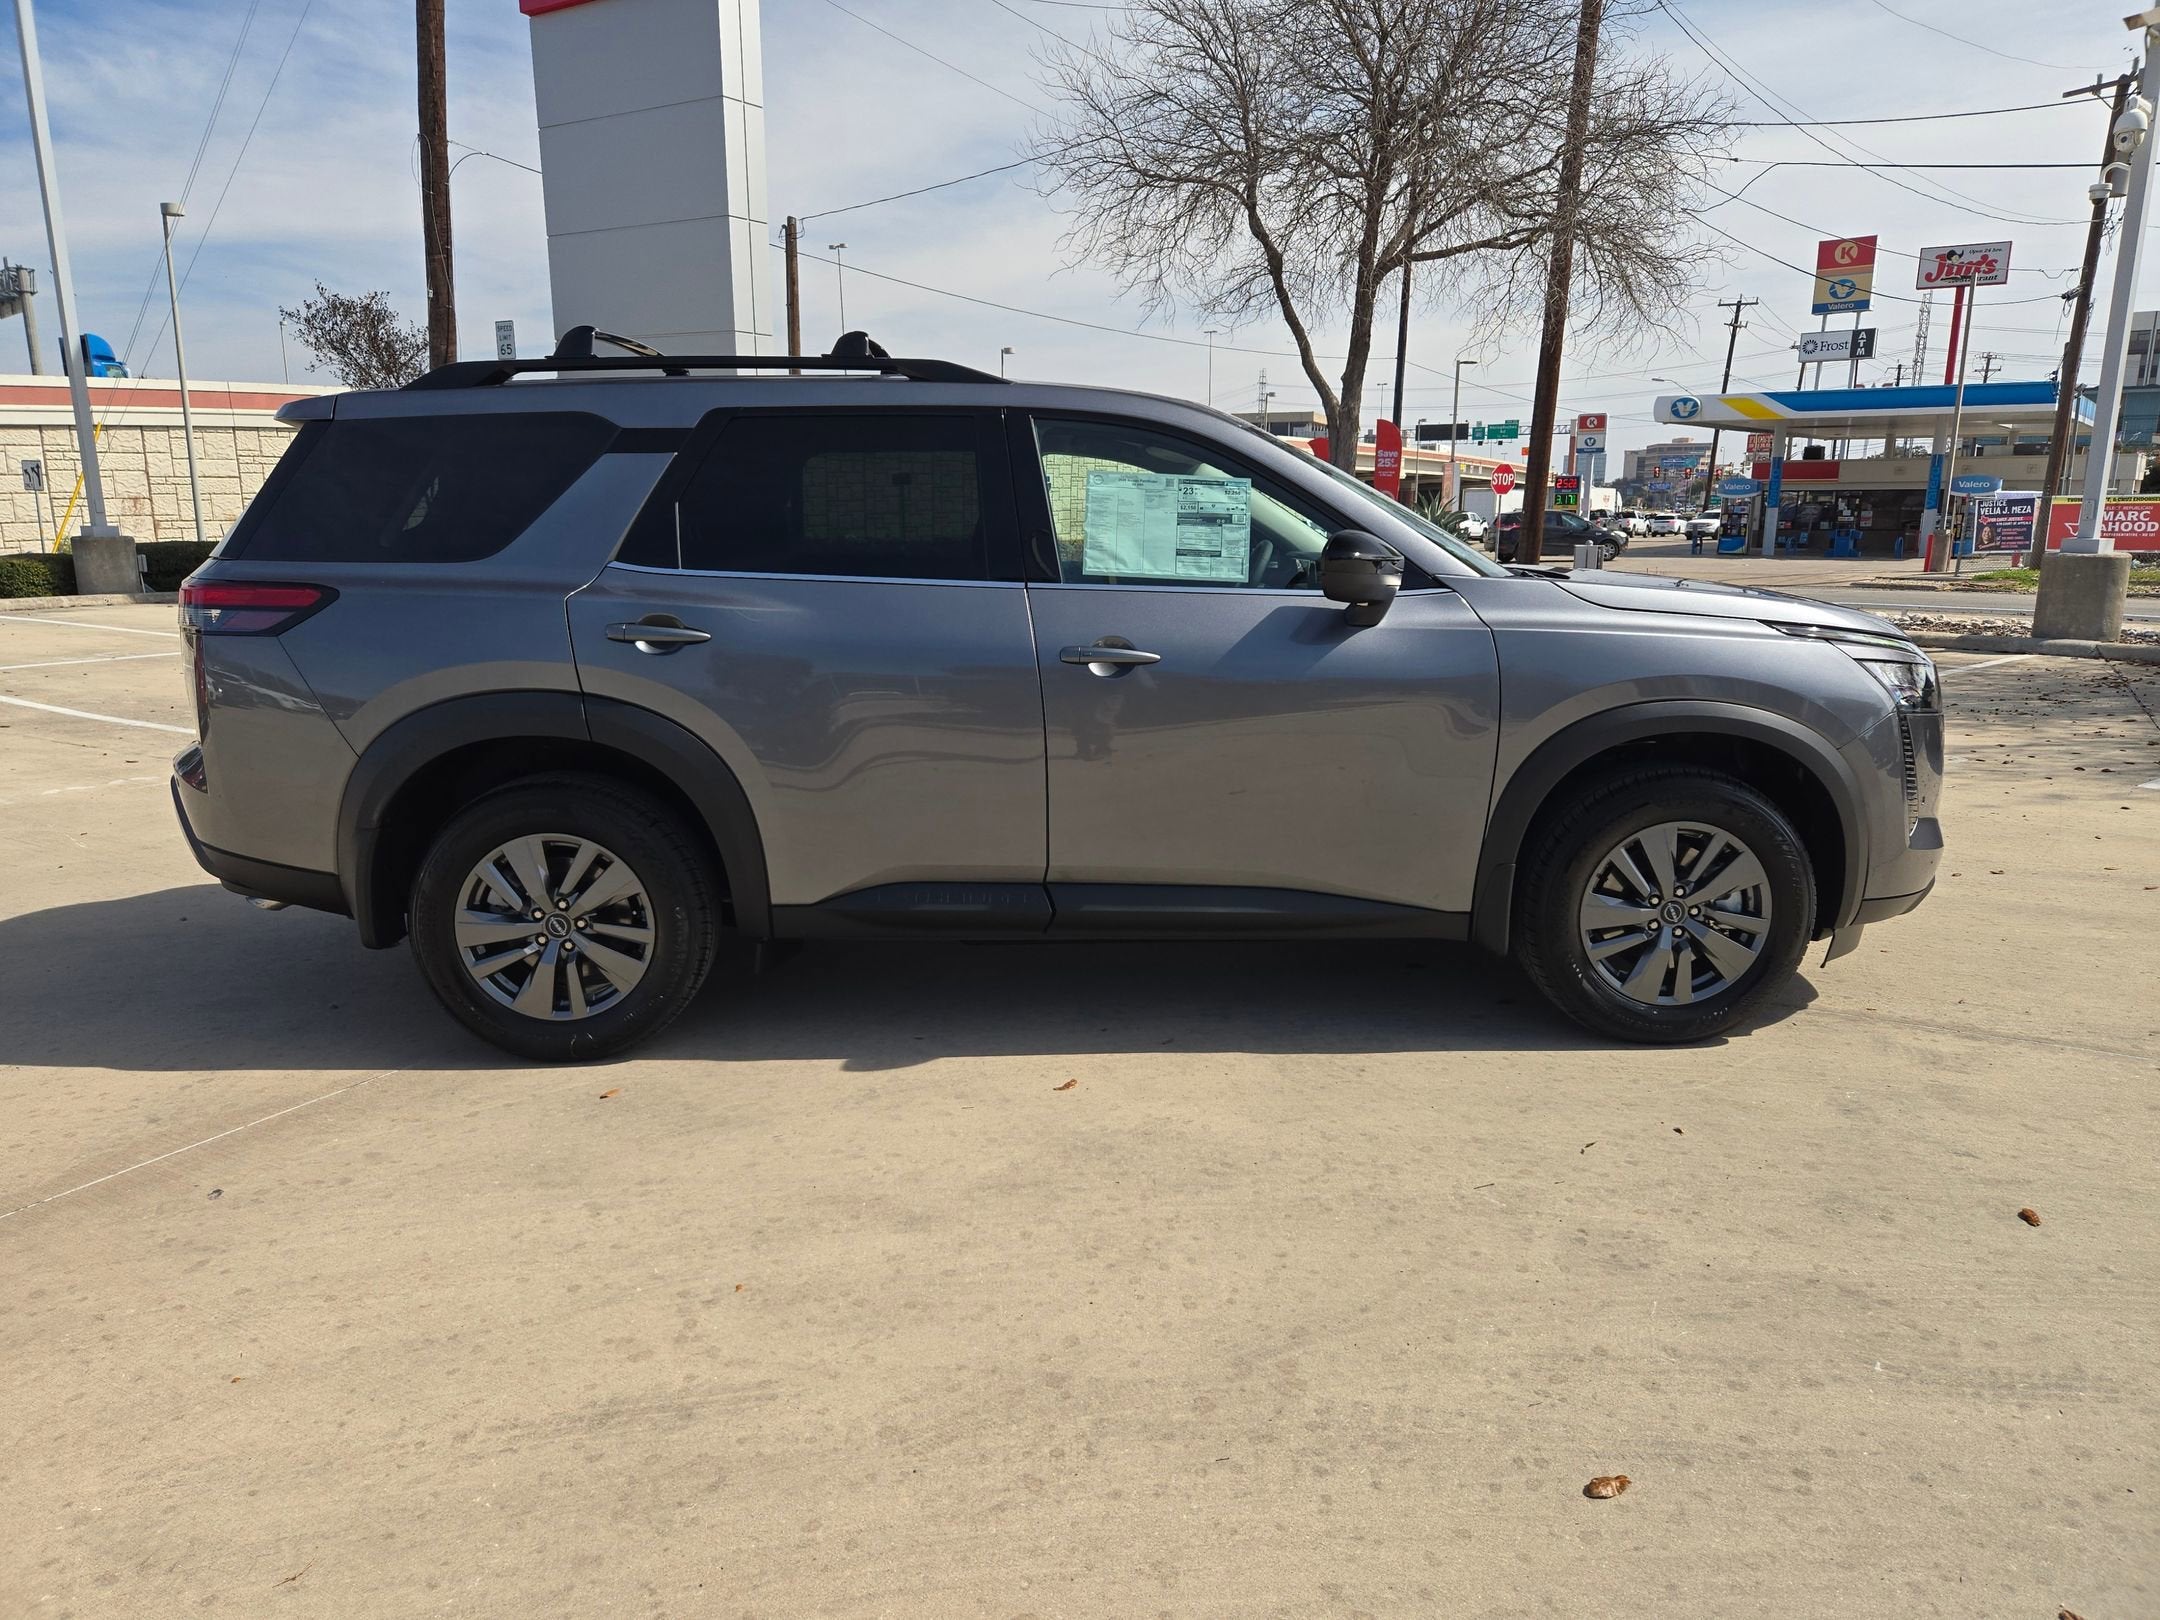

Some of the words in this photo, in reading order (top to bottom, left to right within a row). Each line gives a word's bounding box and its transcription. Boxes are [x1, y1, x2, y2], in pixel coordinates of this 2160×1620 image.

[1841, 246, 1855, 259] K
[1924, 252, 1999, 283] Jim's
[1827, 302, 1855, 311] Valero
[1820, 340, 1850, 351] Frost
[1856, 331, 1867, 356] ATM
[500, 343, 513, 355] 65
[1377, 449, 1399, 458] Save
[1492, 473, 1514, 485] STOP
[1958, 480, 1990, 488] Valero
[1183, 487, 1194, 495] 23
[1980, 499, 2008, 507] JUSTICE
[1980, 507, 2001, 515] VELIA
[2011, 505, 2032, 513] MEZA
[2103, 511, 2151, 521] MARC
[2100, 522, 2159, 532] AHOOD
